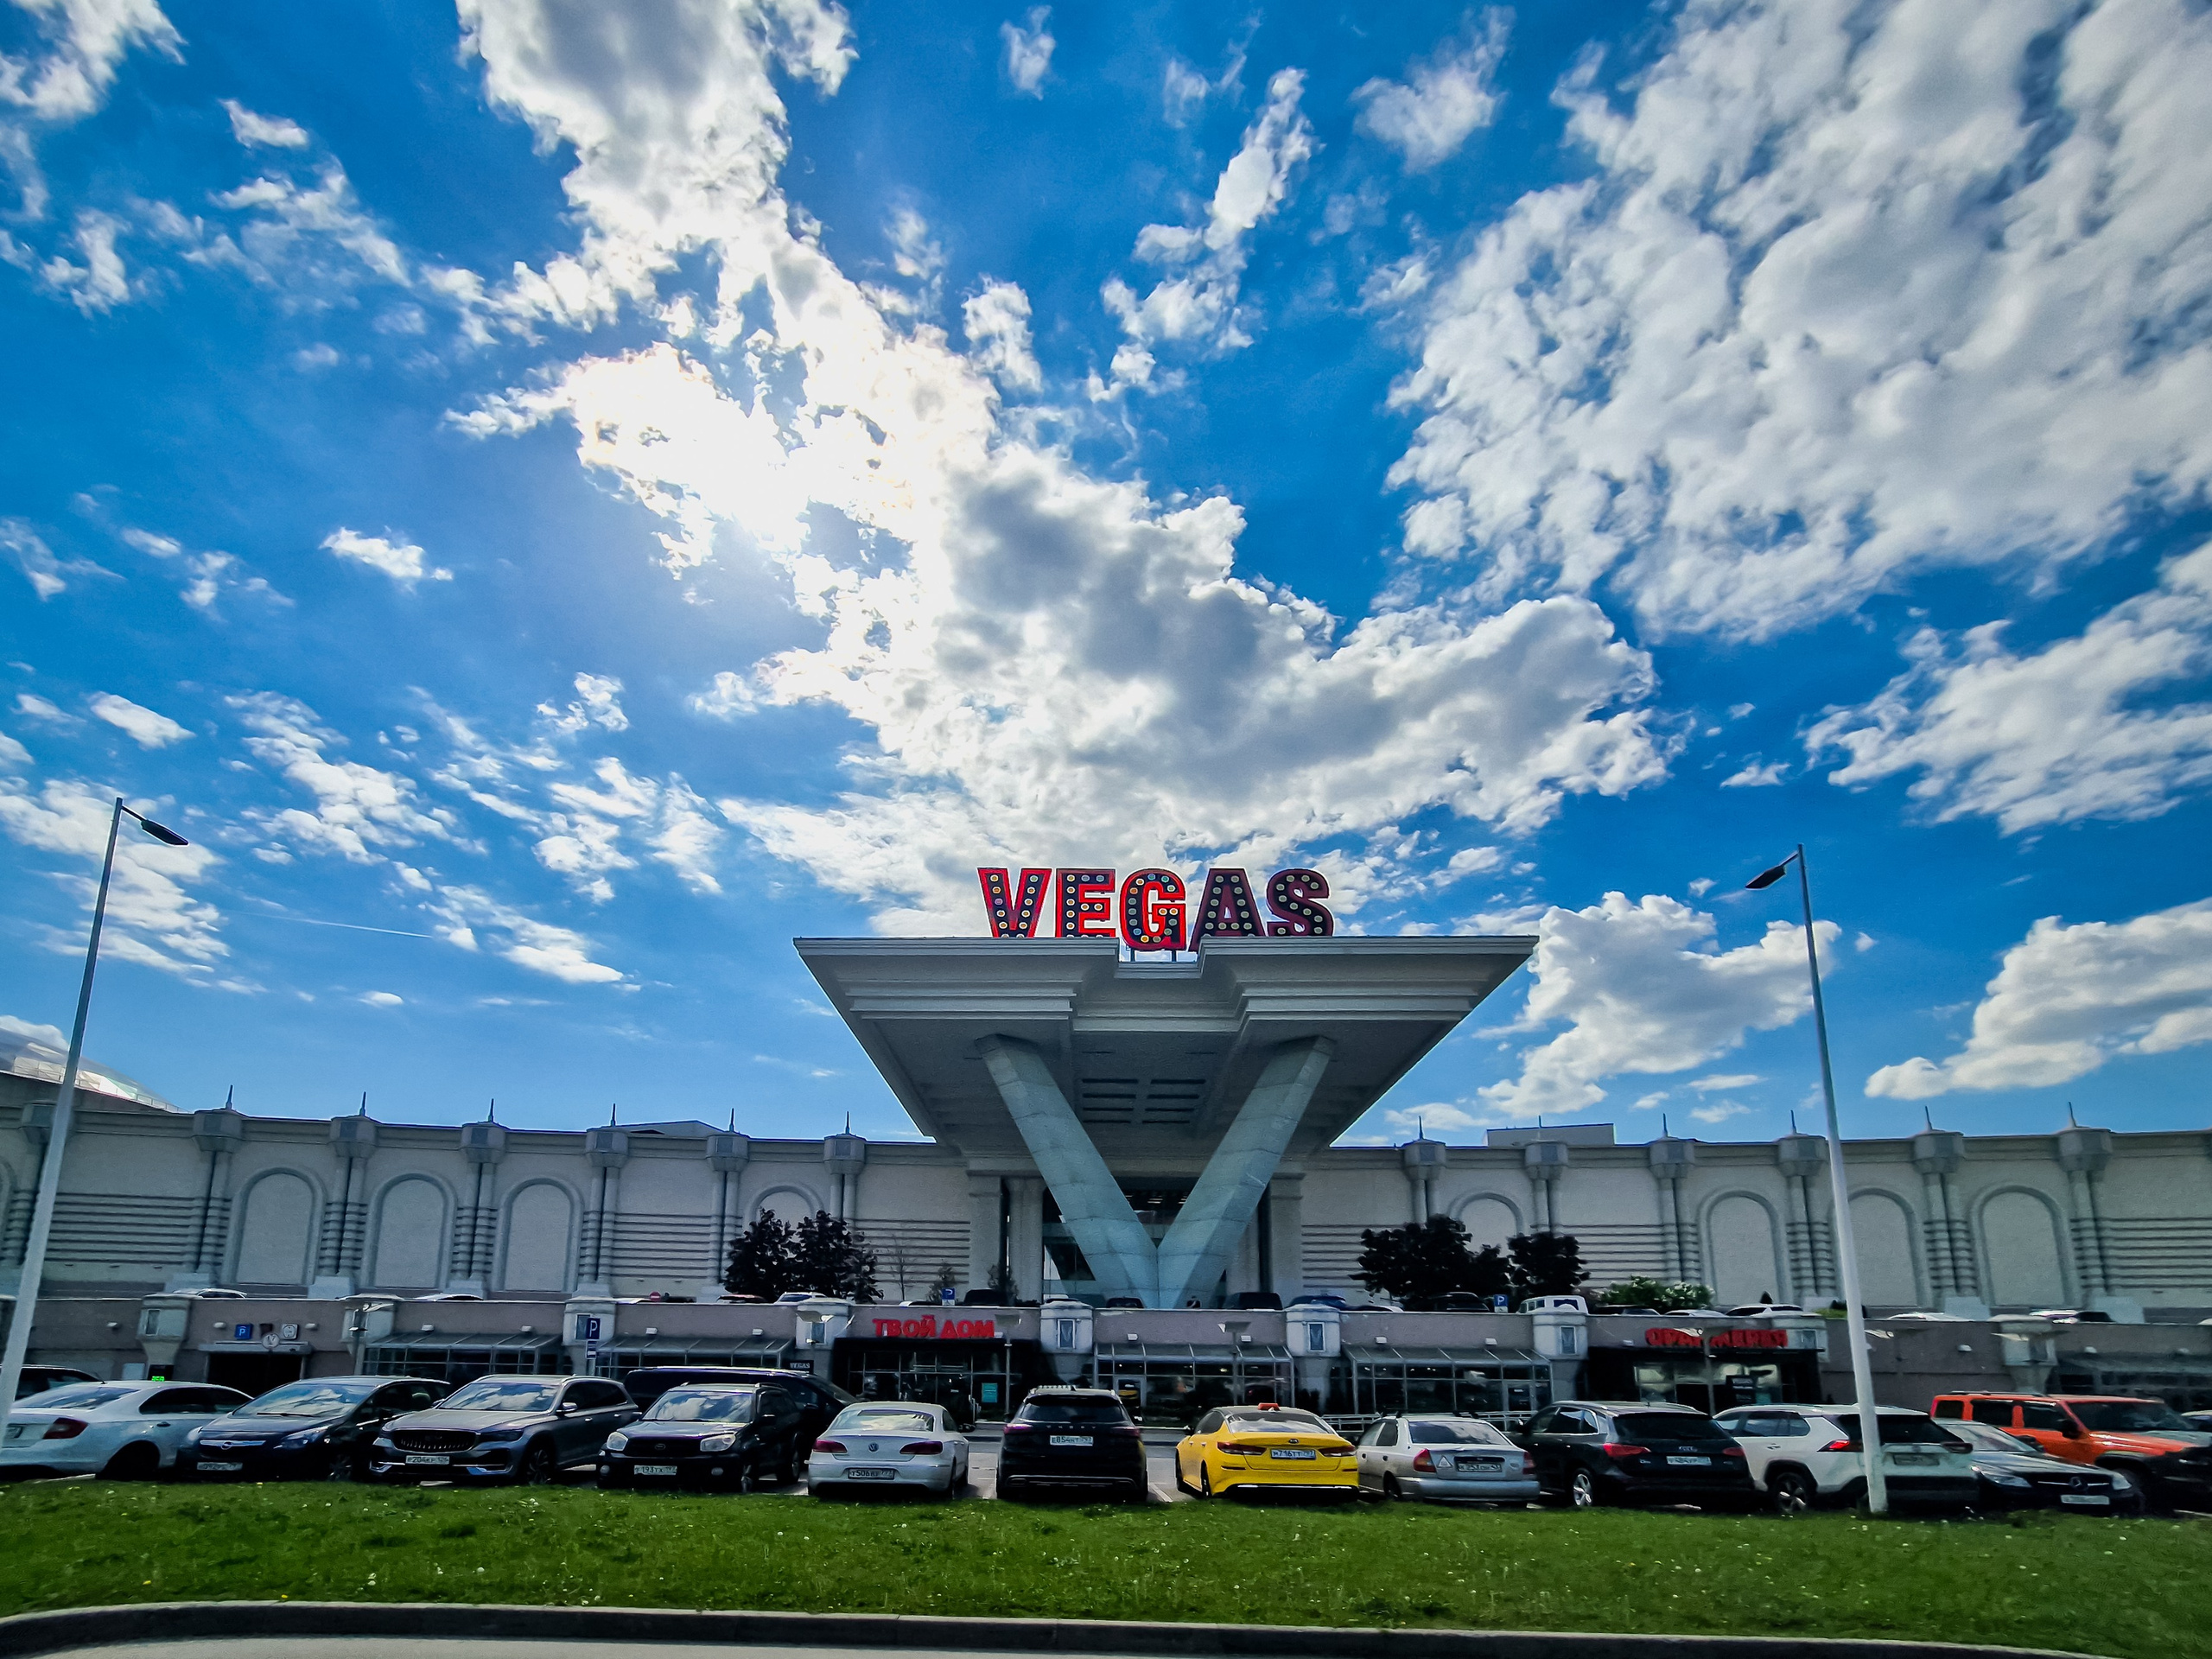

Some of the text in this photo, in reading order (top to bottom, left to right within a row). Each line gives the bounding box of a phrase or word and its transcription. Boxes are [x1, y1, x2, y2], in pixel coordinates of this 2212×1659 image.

[976, 867, 1334, 951] VEGAS
[589, 1319, 598, 1338] P
[872, 1314, 995, 1339] ТВОЙ ДОМ
